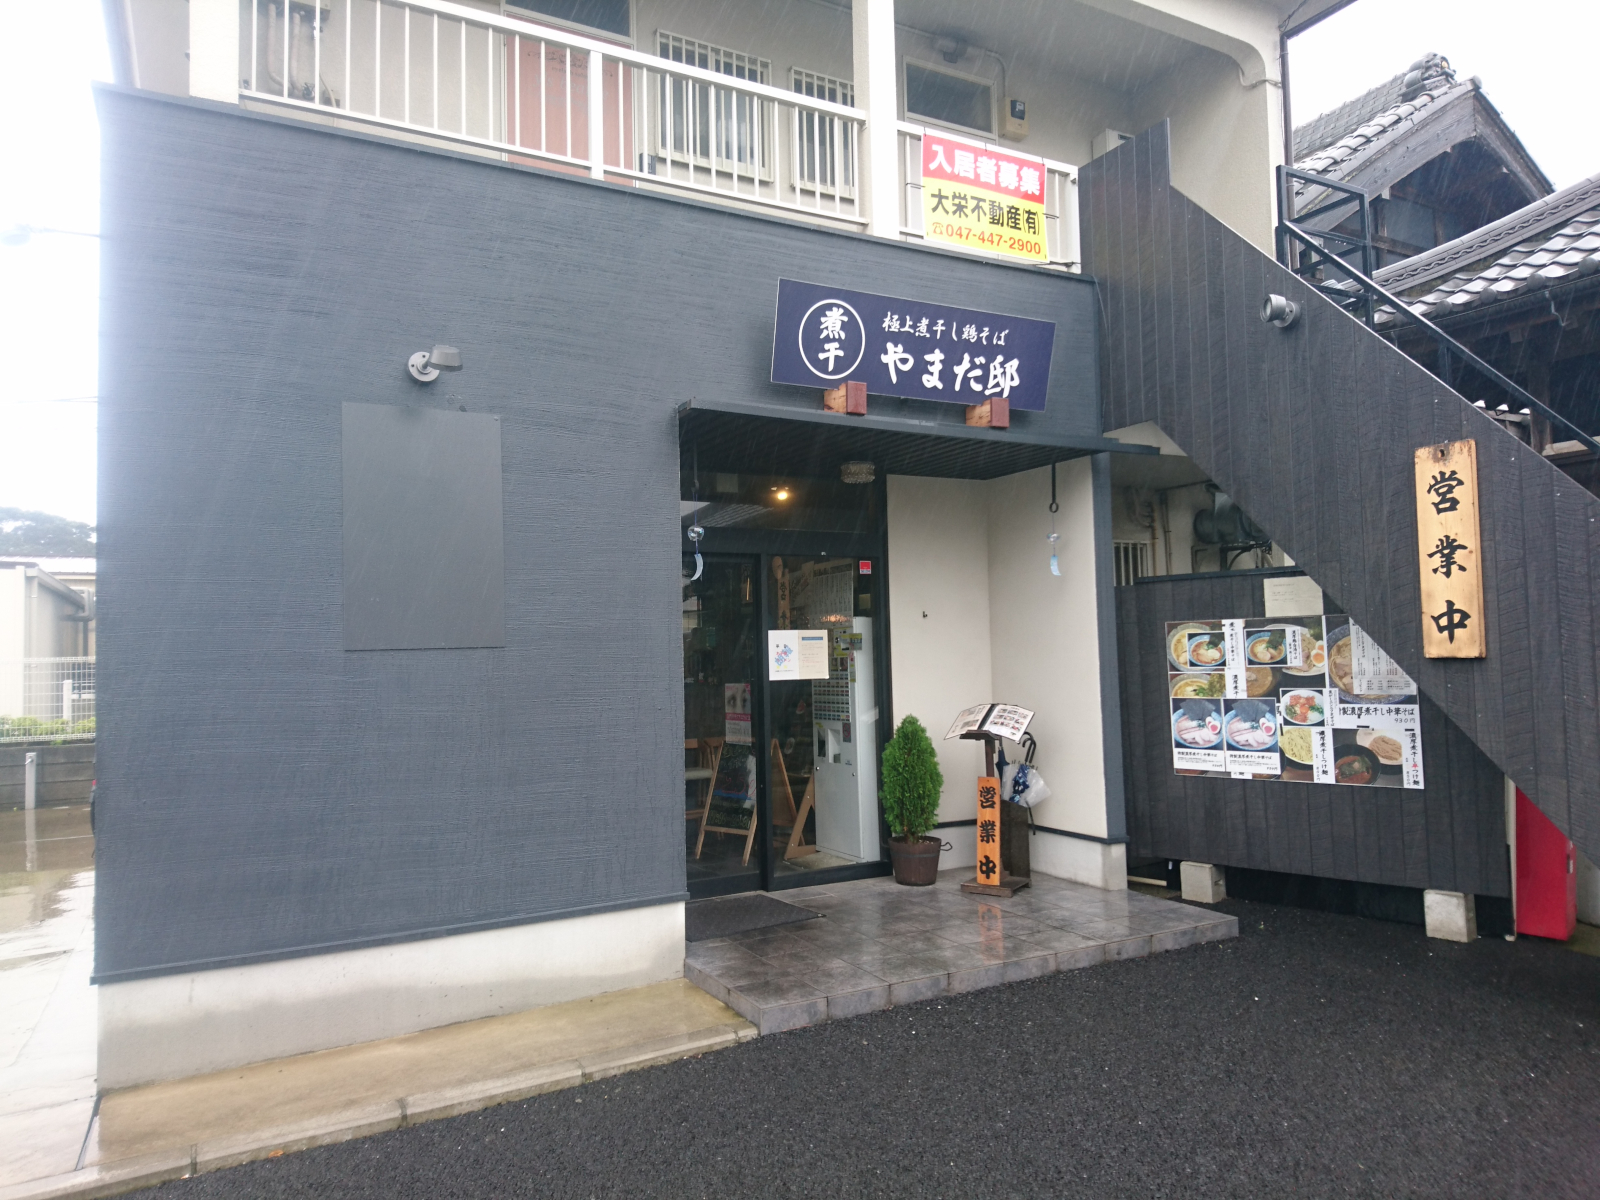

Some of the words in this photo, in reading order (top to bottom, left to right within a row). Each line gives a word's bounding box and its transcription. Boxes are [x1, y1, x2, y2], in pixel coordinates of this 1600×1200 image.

[928, 144, 1041, 195] 入居者募集
[945, 223, 1041, 255] 047-447-2900
[818, 306, 849, 373] 煮干
[882, 311, 1010, 347] 極上煮干し鶏そば
[880, 342, 1021, 399] やまだ邸
[1426, 469, 1472, 645] 営業中
[1338, 706, 1415, 717] 製濃厚煮干し中華そば
[978, 786, 997, 880] 営業中
